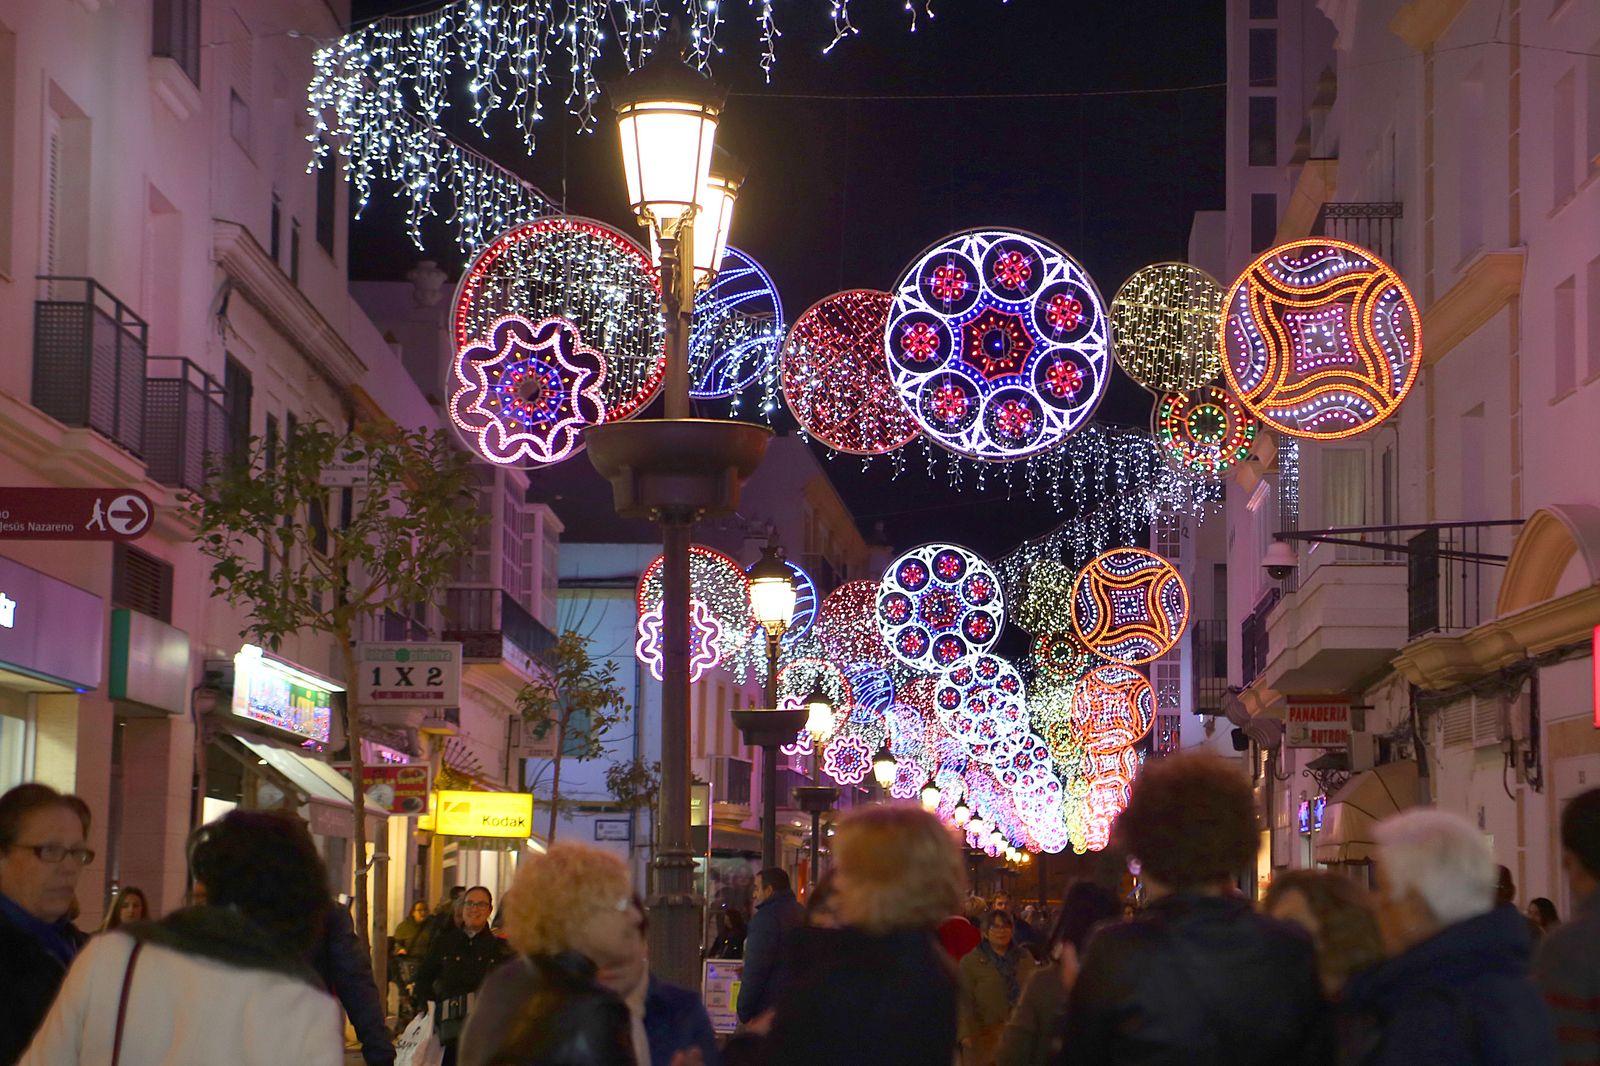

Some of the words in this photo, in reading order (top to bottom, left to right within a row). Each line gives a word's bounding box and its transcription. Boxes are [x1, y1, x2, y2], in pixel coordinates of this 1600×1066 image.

[27, 521, 74, 532] Nazareno
[371, 666, 382, 687] 1
[394, 666, 415, 687] X
[426, 666, 444, 687] 2
[1289, 706, 1348, 722] PANADERIA
[481, 815, 526, 828] Kodak
